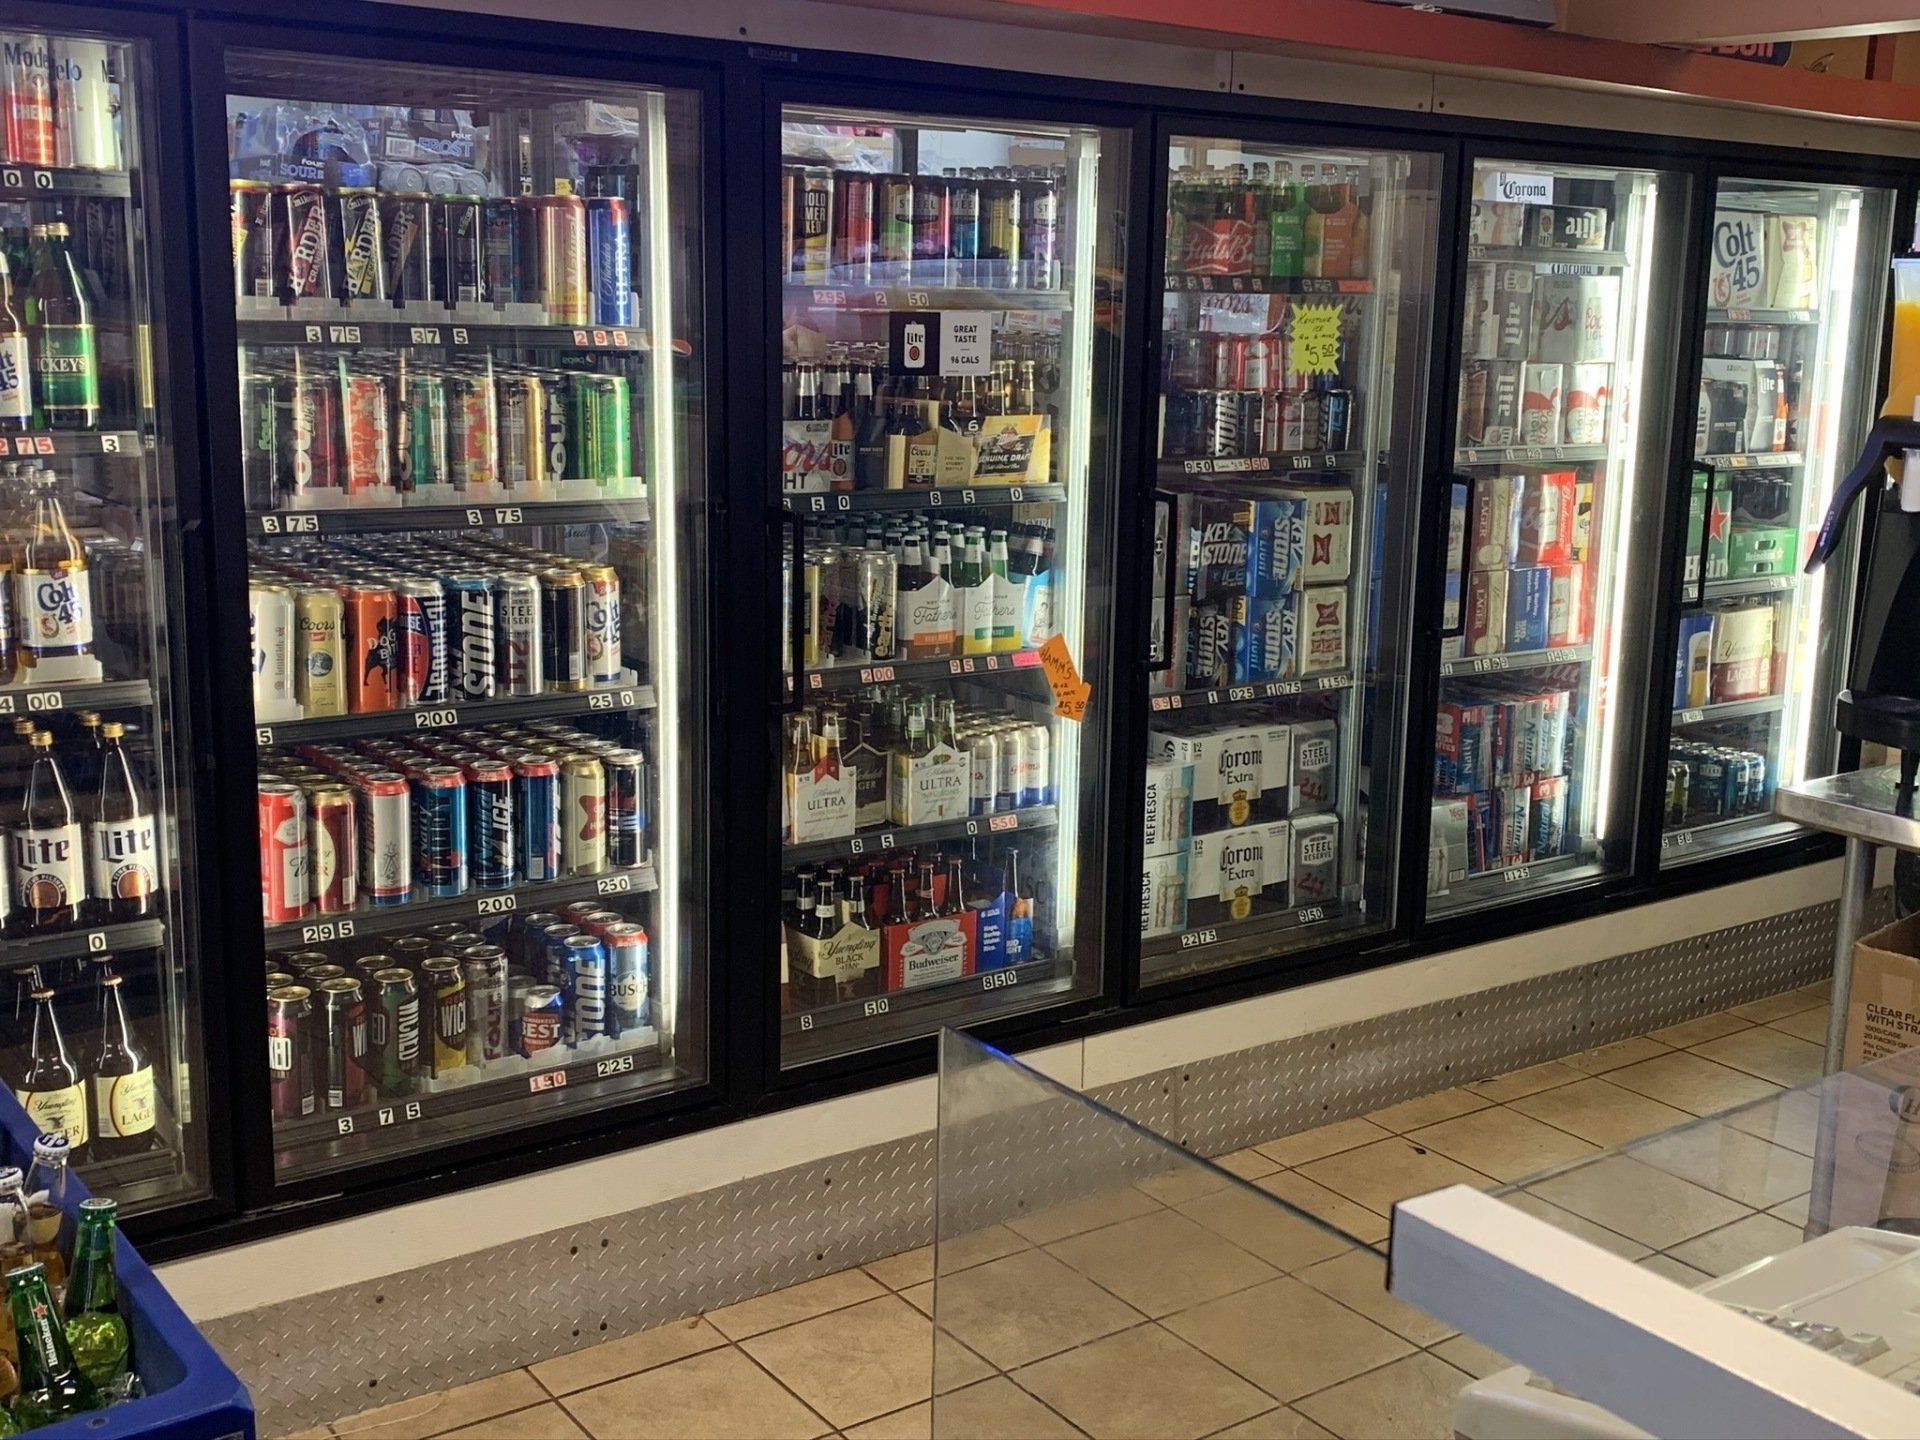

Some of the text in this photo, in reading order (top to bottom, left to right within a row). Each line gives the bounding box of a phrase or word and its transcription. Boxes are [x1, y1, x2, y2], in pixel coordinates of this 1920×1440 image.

[1502, 181, 1547, 200] Corona
[1565, 211, 1598, 240] Lite
[1713, 220, 1758, 269] Colt
[614, 232, 629, 305] ULTRA
[1731, 254, 1760, 292] 45
[910, 293, 929, 306] 50
[953, 325, 978, 333] GREAT
[1503, 301, 1522, 346] Lite
[308, 328, 360, 342] 3 75
[414, 329, 468, 343] 37 5
[906, 332, 924, 346] Lite
[954, 335, 977, 344] TASTE
[1322, 343, 1334, 353] 50
[950, 355, 980, 364] 96 CALS
[1759, 375, 1775, 394] Lite
[1496, 374, 1515, 417] Lite
[967, 420, 979, 431] 6
[105, 439, 118, 452] 3
[831, 443, 851, 459] Lite
[1185, 461, 1211, 472] 950
[1327, 457, 1336, 467] 5
[783, 472, 808, 490] HT
[815, 496, 850, 511] 5 0
[931, 489, 1022, 503] 8 5 0
[265, 517, 318, 532] 3 75
[469, 509, 521, 524] 3 75
[1478, 496, 1490, 538] LAGER
[1203, 522, 1233, 544] KEY
[1290, 516, 1304, 559] KEY
[1200, 541, 1248, 567] STONE
[1271, 517, 1291, 582] STONE
[37, 579, 78, 612] Colt
[585, 599, 620, 633] Colt
[1473, 588, 1486, 631] LAGER
[300, 616, 335, 632] Coors
[1215, 613, 1231, 653] KEY
[1281, 608, 1297, 654] KEY
[422, 599, 448, 699] ICEHOUSE
[462, 589, 496, 699] STONE
[1196, 615, 1218, 678] STONE
[1264, 609, 1282, 672] STONE
[951, 658, 997, 672] 95 0
[1040, 647, 1074, 680] HAMM'S
[811, 675, 821, 687] 5
[862, 668, 894, 682] 200
[1319, 676, 1347, 689] 1150
[1268, 682, 1301, 697] 1075
[590, 694, 633, 710] 25 0
[418, 711, 456, 729] 200
[259, 729, 271, 742] 5
[1193, 742, 1203, 753] 12
[1301, 746, 1329, 759] STEEL
[1523, 720, 1537, 774] Natural
[919, 776, 961, 791] ULTRA
[1226, 771, 1254, 785] Extra
[492, 792, 511, 833] ICE
[807, 796, 847, 811] ULTRA
[990, 816, 1017, 831] 550
[1145, 783, 1158, 846] REFRESCA
[478, 786, 493, 869] Natural
[1513, 803, 1526, 855] Natural
[1535, 801, 1552, 856] Natural
[99, 828, 152, 864] Lite
[853, 822, 977, 852] 8 5 0
[1194, 840, 1204, 851] 12
[17, 838, 70, 872] Lite
[1303, 840, 1331, 854] STEEL
[1227, 867, 1255, 881] Extra
[1505, 868, 1530, 882] 1125
[599, 878, 629, 893] 250
[478, 896, 515, 914] 200
[1299, 909, 1323, 921] 950
[305, 925, 353, 941] 295
[92, 936, 105, 949] 0
[822, 939, 877, 961] Yuengling
[834, 952, 865, 967] BLACK
[908, 953, 959, 971] Budweiser
[984, 971, 1017, 989] 850
[802, 1000, 888, 1028] 8 50
[1865, 1012, 1896, 1028] WITH
[1866, 1002, 1904, 1021] CLEAR
[398, 999, 420, 1061] WICKED
[598, 1057, 634, 1077] 225
[340, 1105, 419, 1132] 3 7 5
[40, 1317, 58, 1367] Heineken
